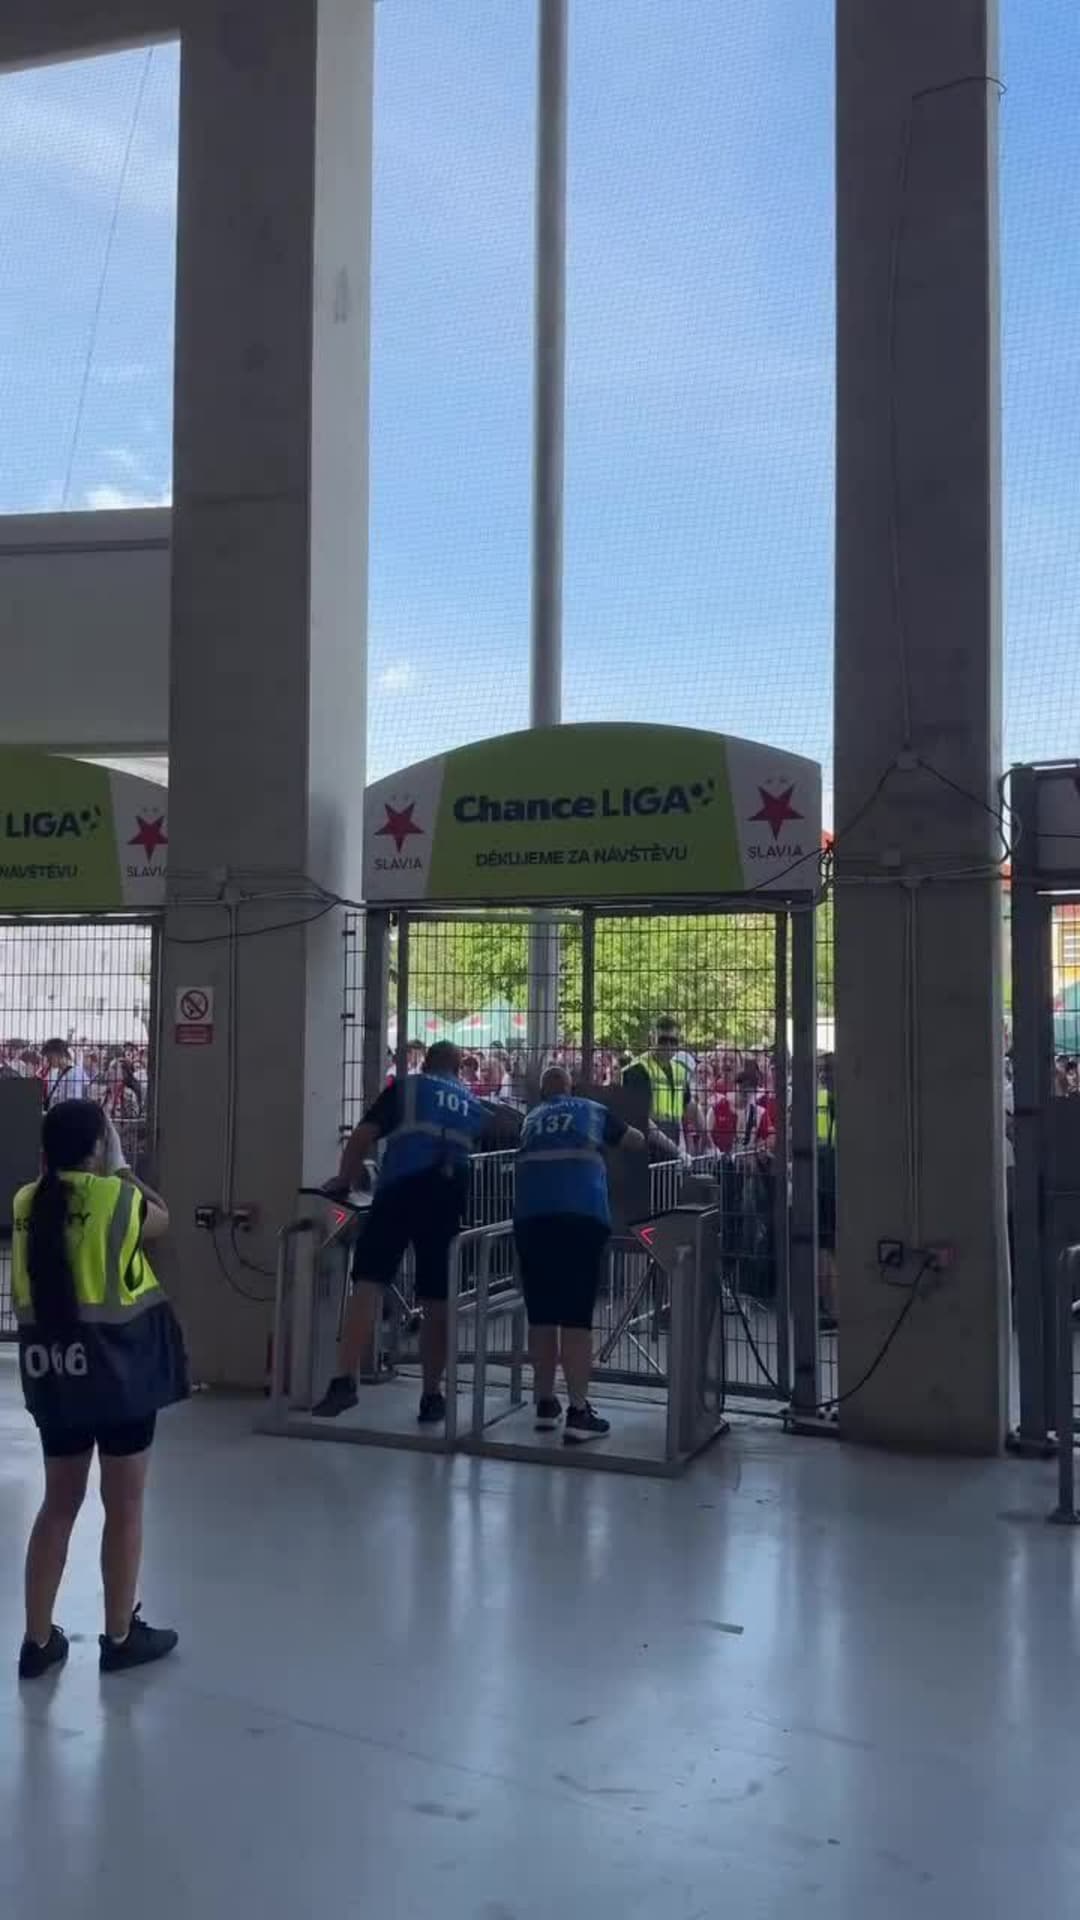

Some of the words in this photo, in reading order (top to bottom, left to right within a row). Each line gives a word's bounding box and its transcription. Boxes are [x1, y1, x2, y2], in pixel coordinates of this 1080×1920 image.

[453, 795, 594, 823] Chance
[602, 786, 691, 817] LIGA
[5, 812, 81, 838] LIGA
[374, 857, 423, 871] SLAVIA
[567, 849, 592, 865] ZA
[746, 845, 804, 860] SLAVIA
[434, 1089, 470, 1117] 101
[534, 1112, 575, 1137] 137
